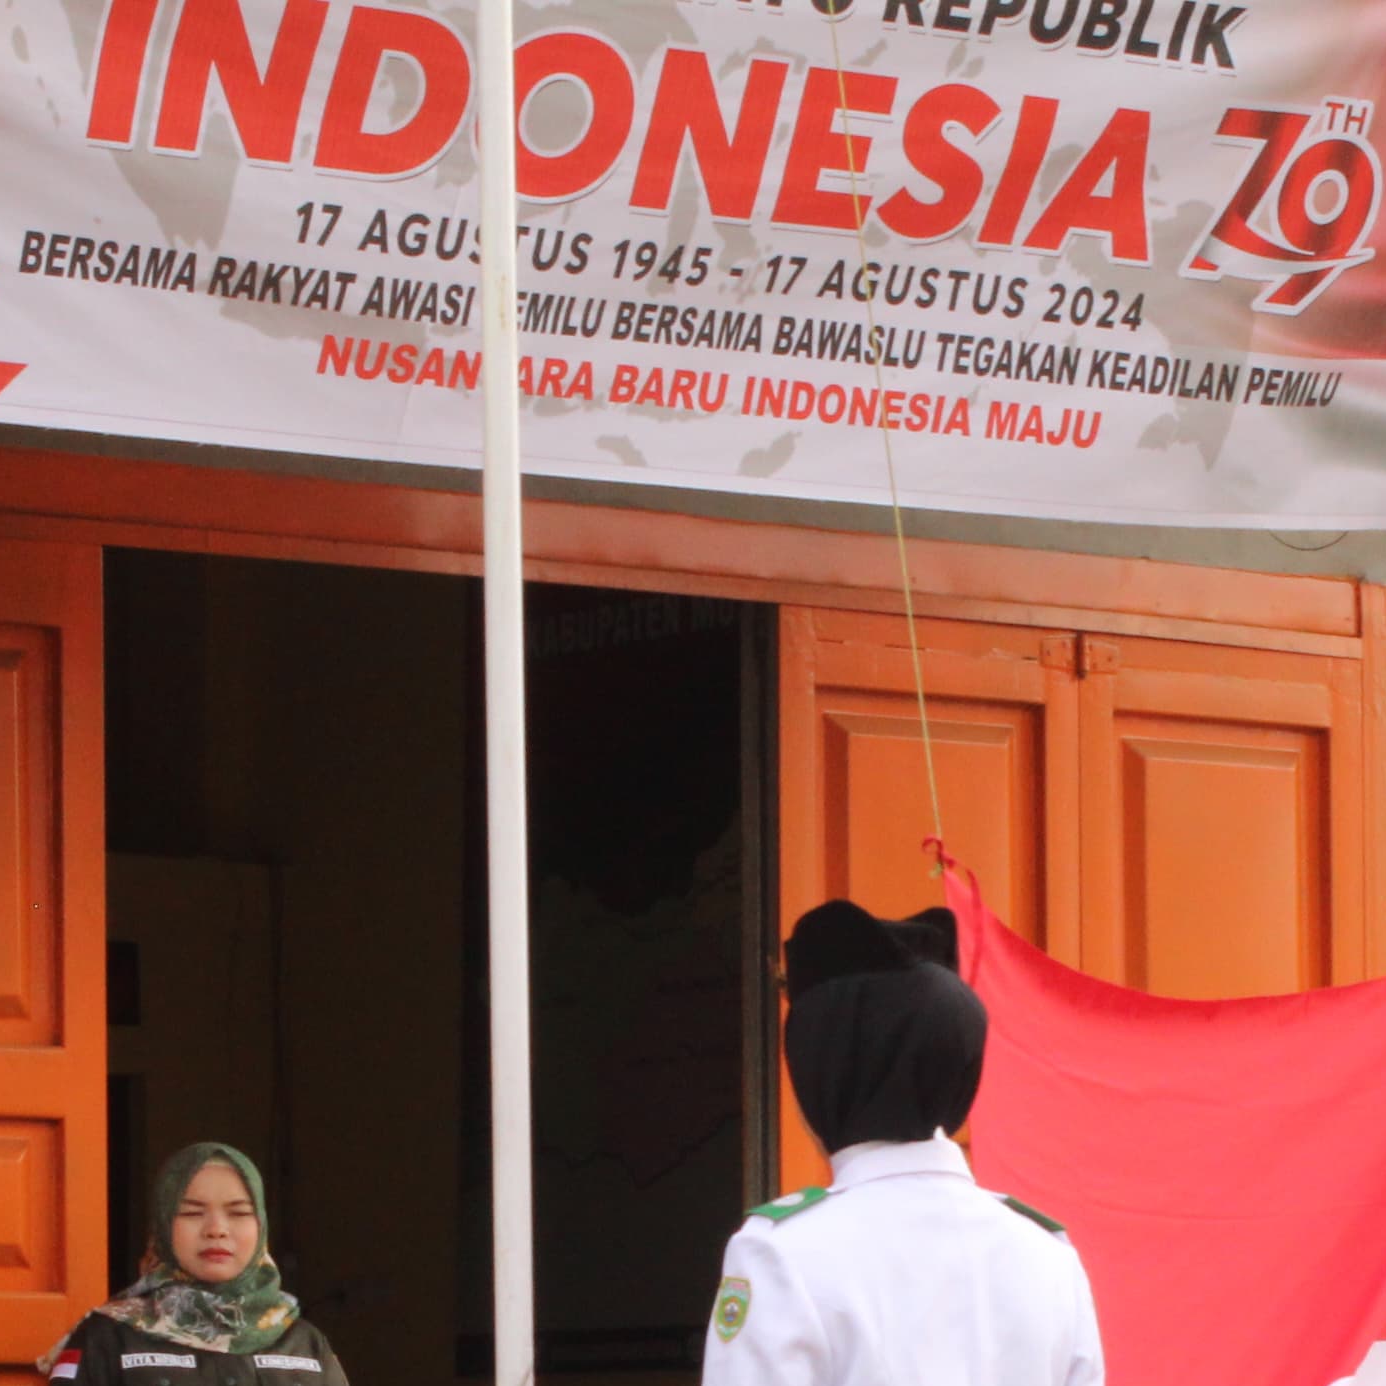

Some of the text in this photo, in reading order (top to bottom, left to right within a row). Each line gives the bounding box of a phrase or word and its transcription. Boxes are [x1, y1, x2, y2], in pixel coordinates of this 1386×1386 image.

[85, 0, 1153, 262] INDONESIA
[1186, 100, 1376, 308] 79 TH
[18, 230, 199, 293] BERSAMA
[206, 256, 358, 313] RAKYAT
[360, 276, 476, 327] AWASI
[610, 301, 764, 354] BERSAMA
[772, 315, 927, 370] BAWASLU
[936, 332, 1083, 387] TEGAKAN
[1086, 349, 1241, 404] KEADILAN
[1242, 367, 1344, 408] PEMILU
[295, 200, 343, 248] 17
[612, 239, 713, 286] 1945
[764, 254, 808, 294] 17
[816, 259, 1029, 319] AGUSTUS
[1042, 284, 1146, 332] 2024
[316, 334, 1103, 450] NUSANARA BARU INDONESIA MAJU
